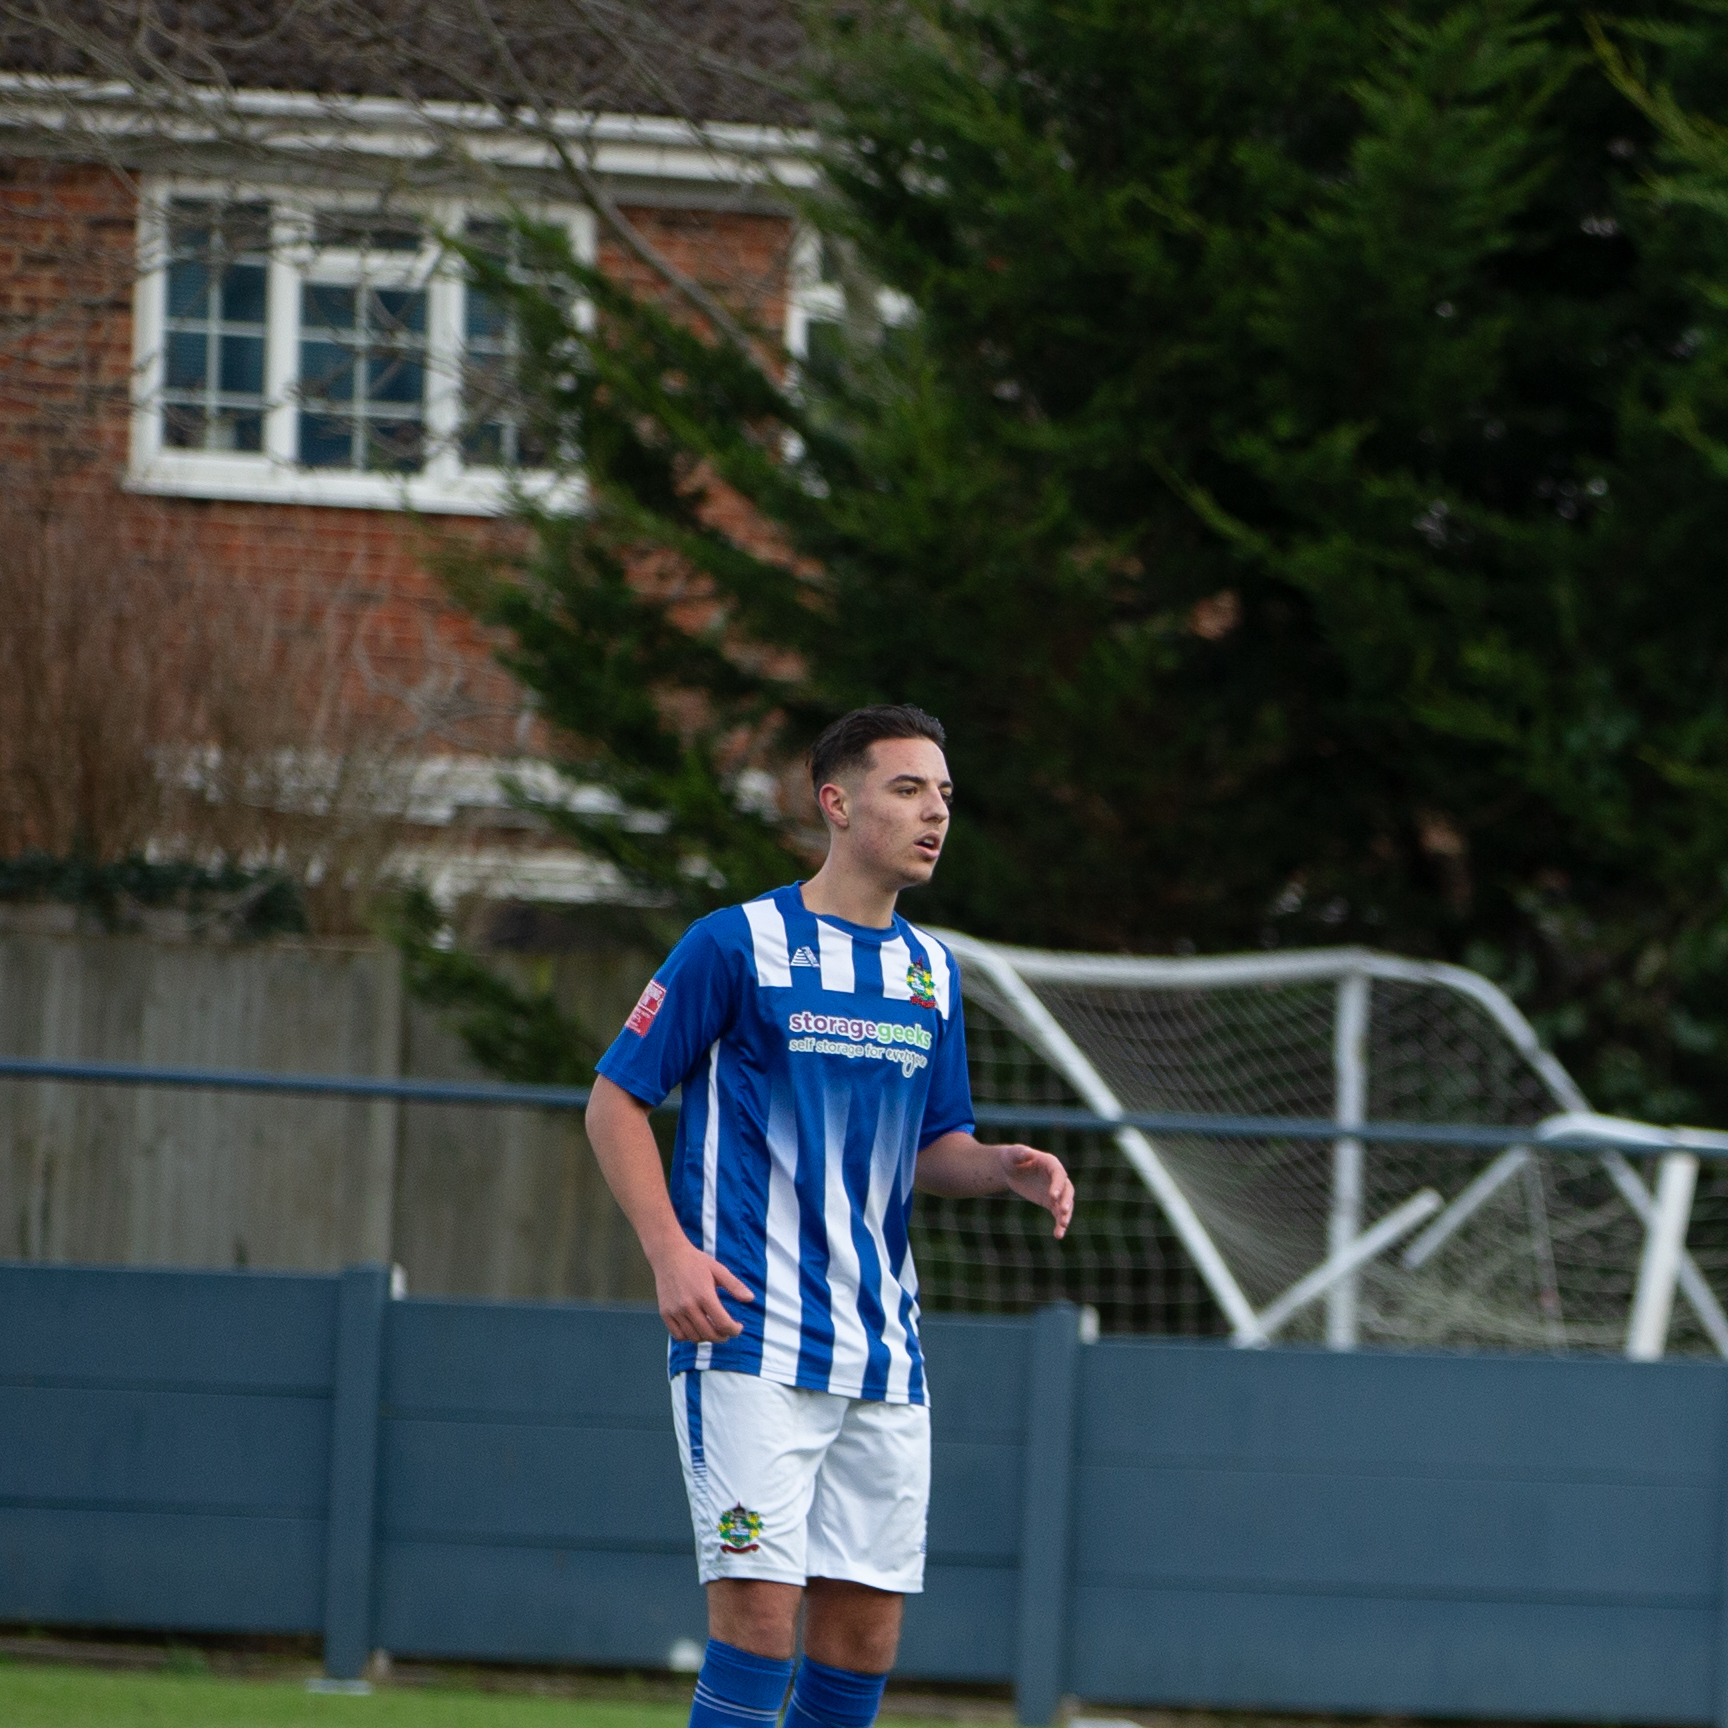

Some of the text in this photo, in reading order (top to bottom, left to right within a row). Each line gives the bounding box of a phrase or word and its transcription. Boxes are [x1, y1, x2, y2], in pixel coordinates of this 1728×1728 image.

[789, 1011, 933, 1050] storagegeeks
[789, 1037, 815, 1053] self
[815, 1040, 863, 1059] storage
[864, 1043, 885, 1058] for
